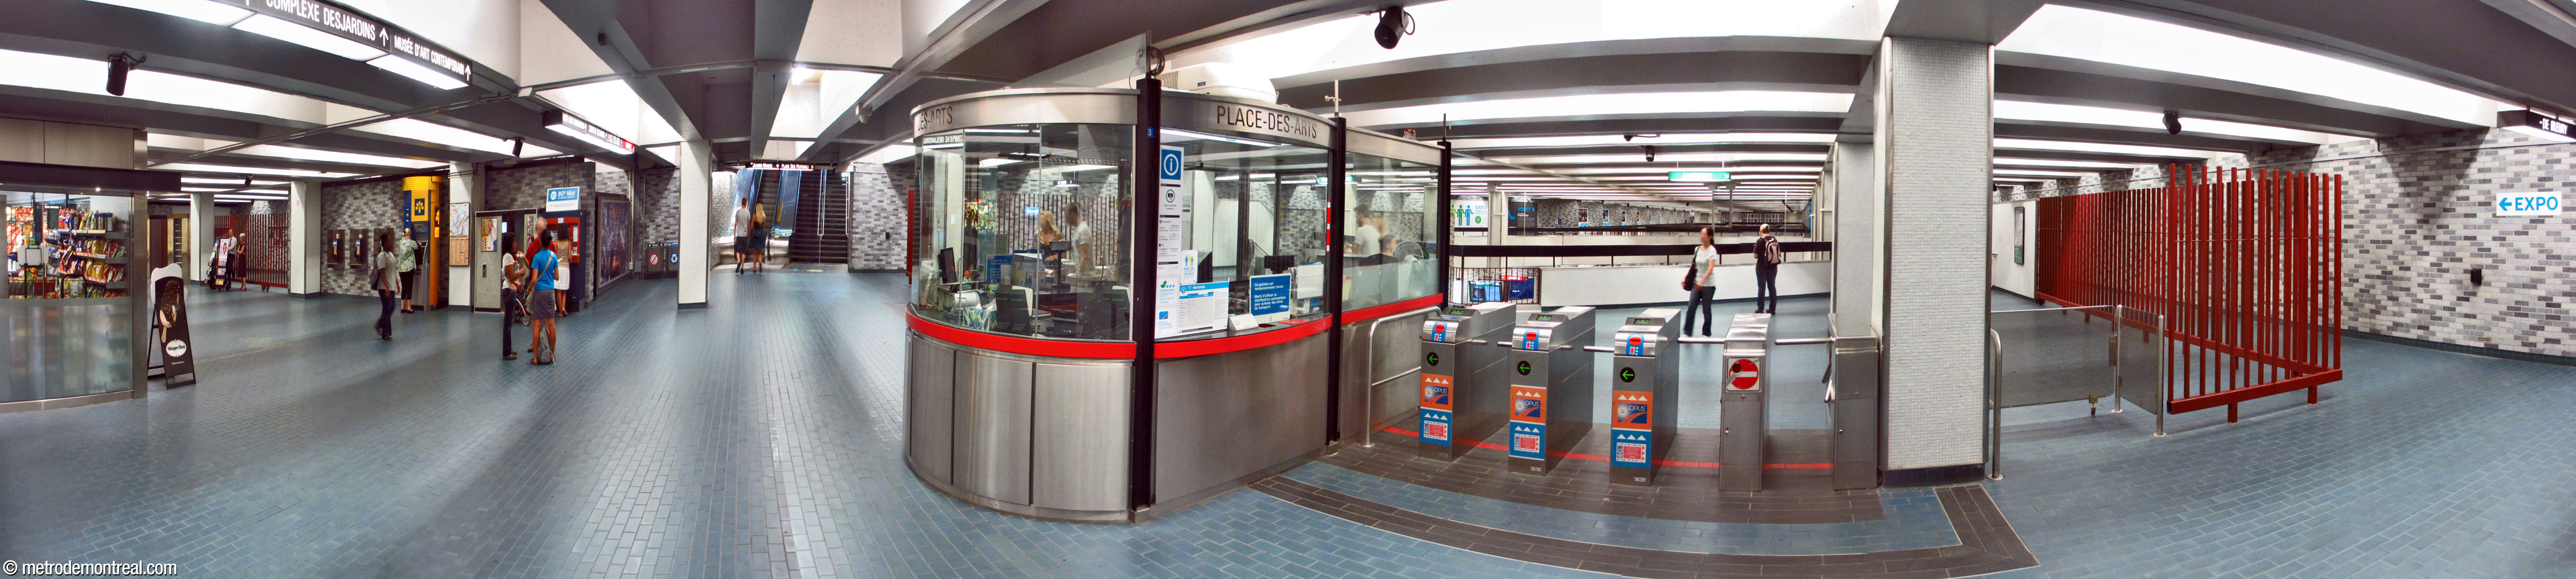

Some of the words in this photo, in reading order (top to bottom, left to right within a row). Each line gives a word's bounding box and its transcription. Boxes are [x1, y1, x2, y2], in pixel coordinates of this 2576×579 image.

[323, 7, 375, 41] DESJARDINS
[394, 35, 414, 55] MUSÉE
[415, 43, 430, 61] D'ART
[431, 50, 464, 75] CONTEMPORAIN
[1217, 105, 1316, 139] PLACE-DES-ARTS
[2542, 118, 2549, 130] DE
[2551, 120, 2568, 135] BLEURY
[2515, 196, 2558, 211] EXPO
